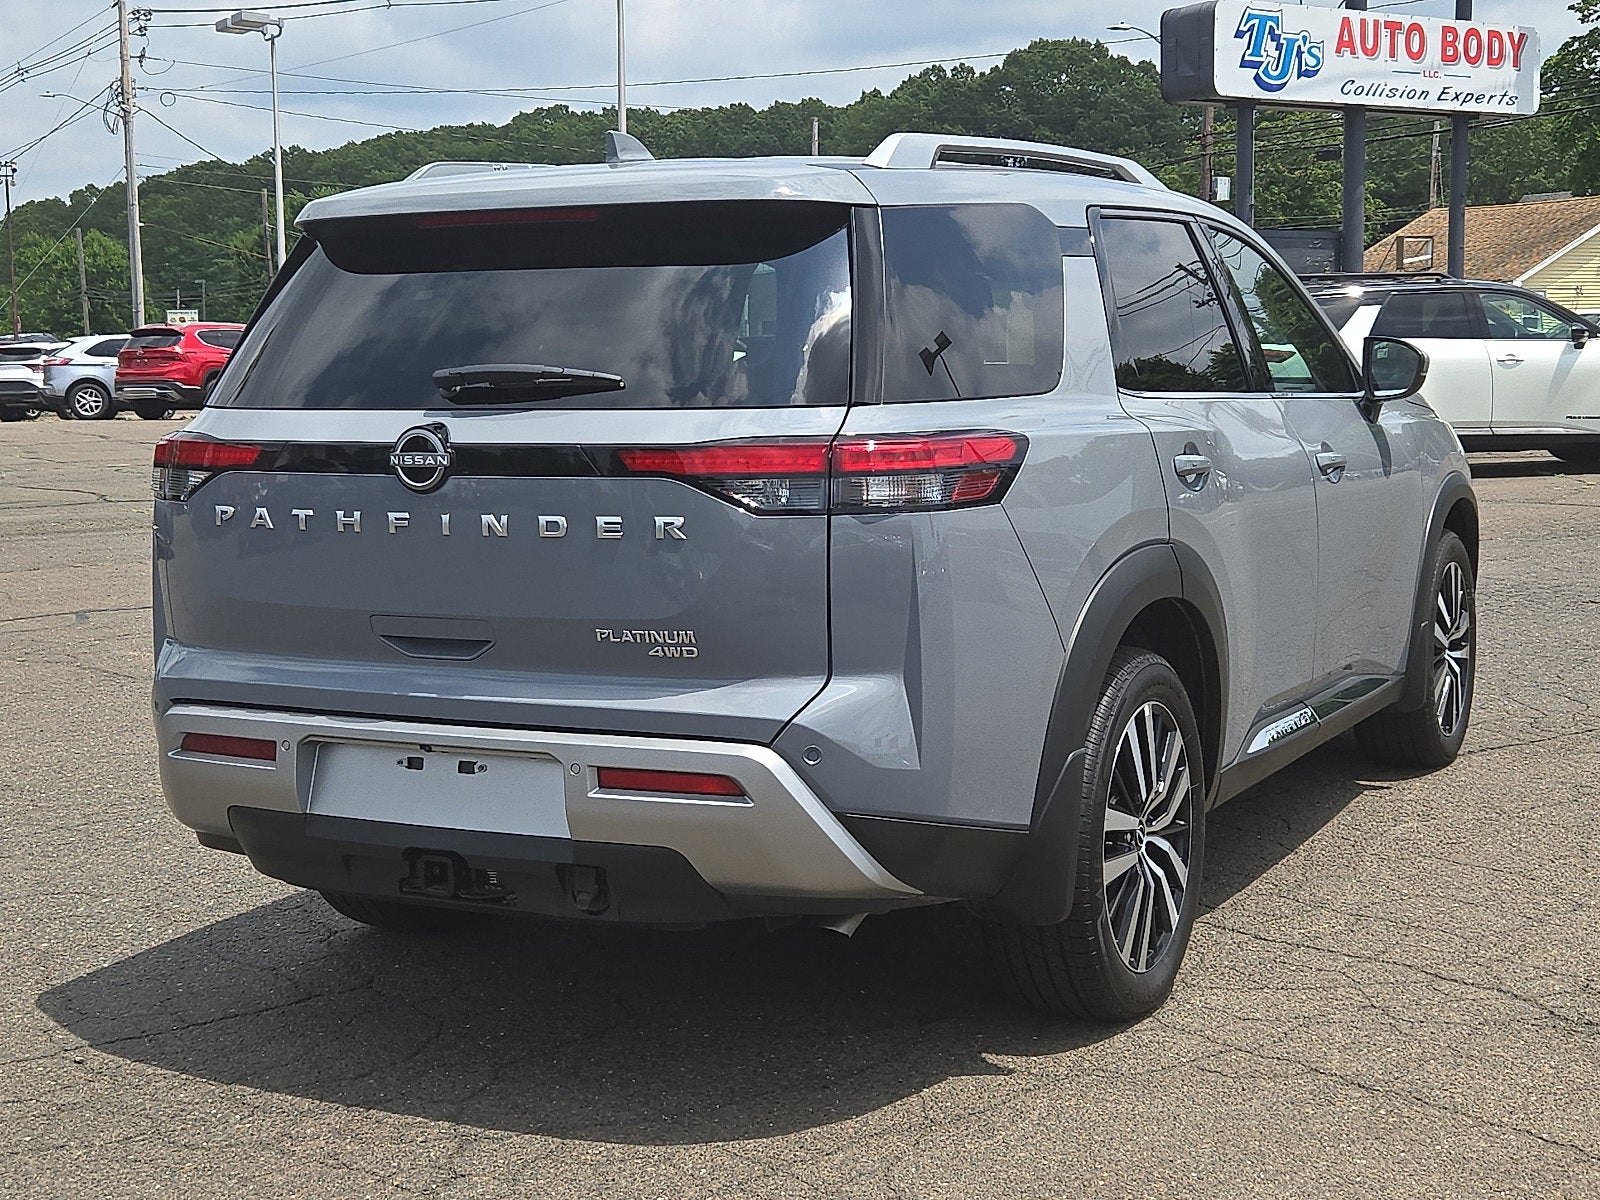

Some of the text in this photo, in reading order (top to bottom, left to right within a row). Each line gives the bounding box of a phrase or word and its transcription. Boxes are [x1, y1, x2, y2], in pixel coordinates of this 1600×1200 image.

[1233, 6, 1527, 92] TJ's AUTO BODY
[1422, 70, 1442, 79] LLC.
[1340, 79, 1519, 107] Collision Experts
[390, 455, 448, 465] NISSAN
[214, 504, 688, 540] PATHFINDER
[595, 628, 697, 644] PLATINUM
[648, 646, 699, 658] 4WD
